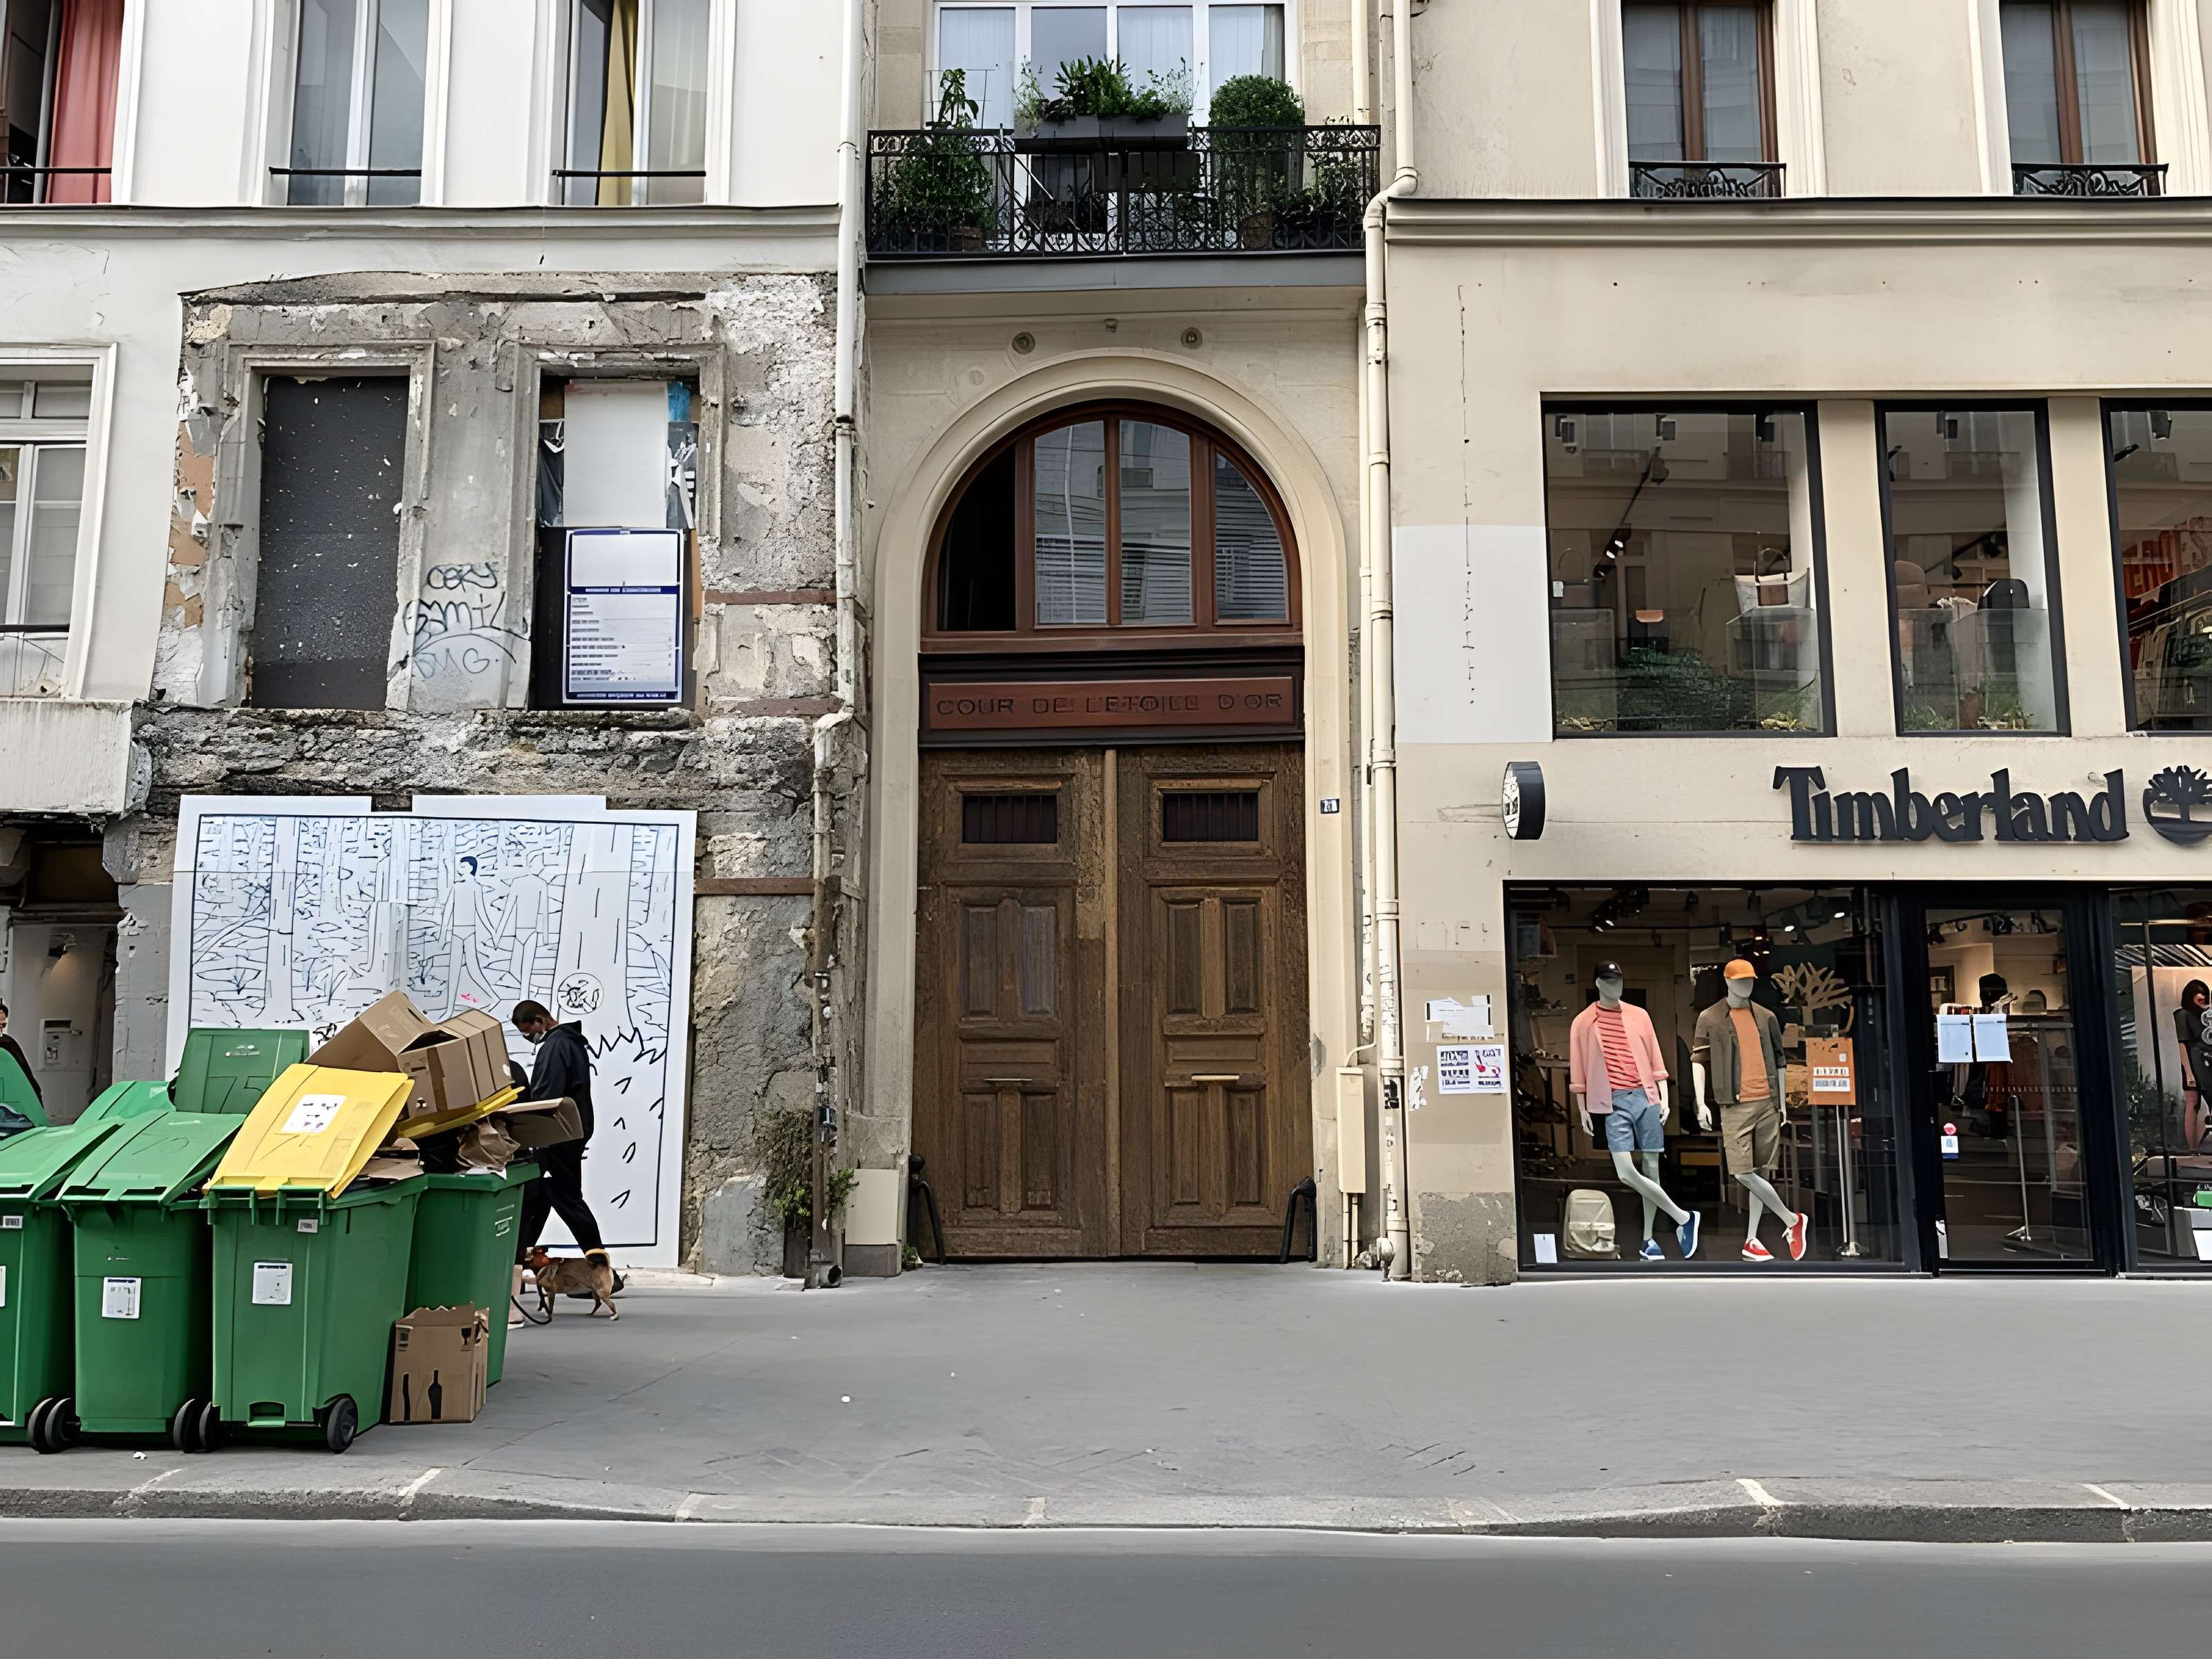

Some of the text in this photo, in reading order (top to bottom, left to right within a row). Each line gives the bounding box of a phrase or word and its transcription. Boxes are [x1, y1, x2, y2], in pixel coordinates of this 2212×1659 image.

[937, 698, 1014, 715] COUR
[1033, 697, 1074, 713] DE
[1218, 693, 1282, 710] D'OR
[1772, 765, 2130, 842] Timberland
